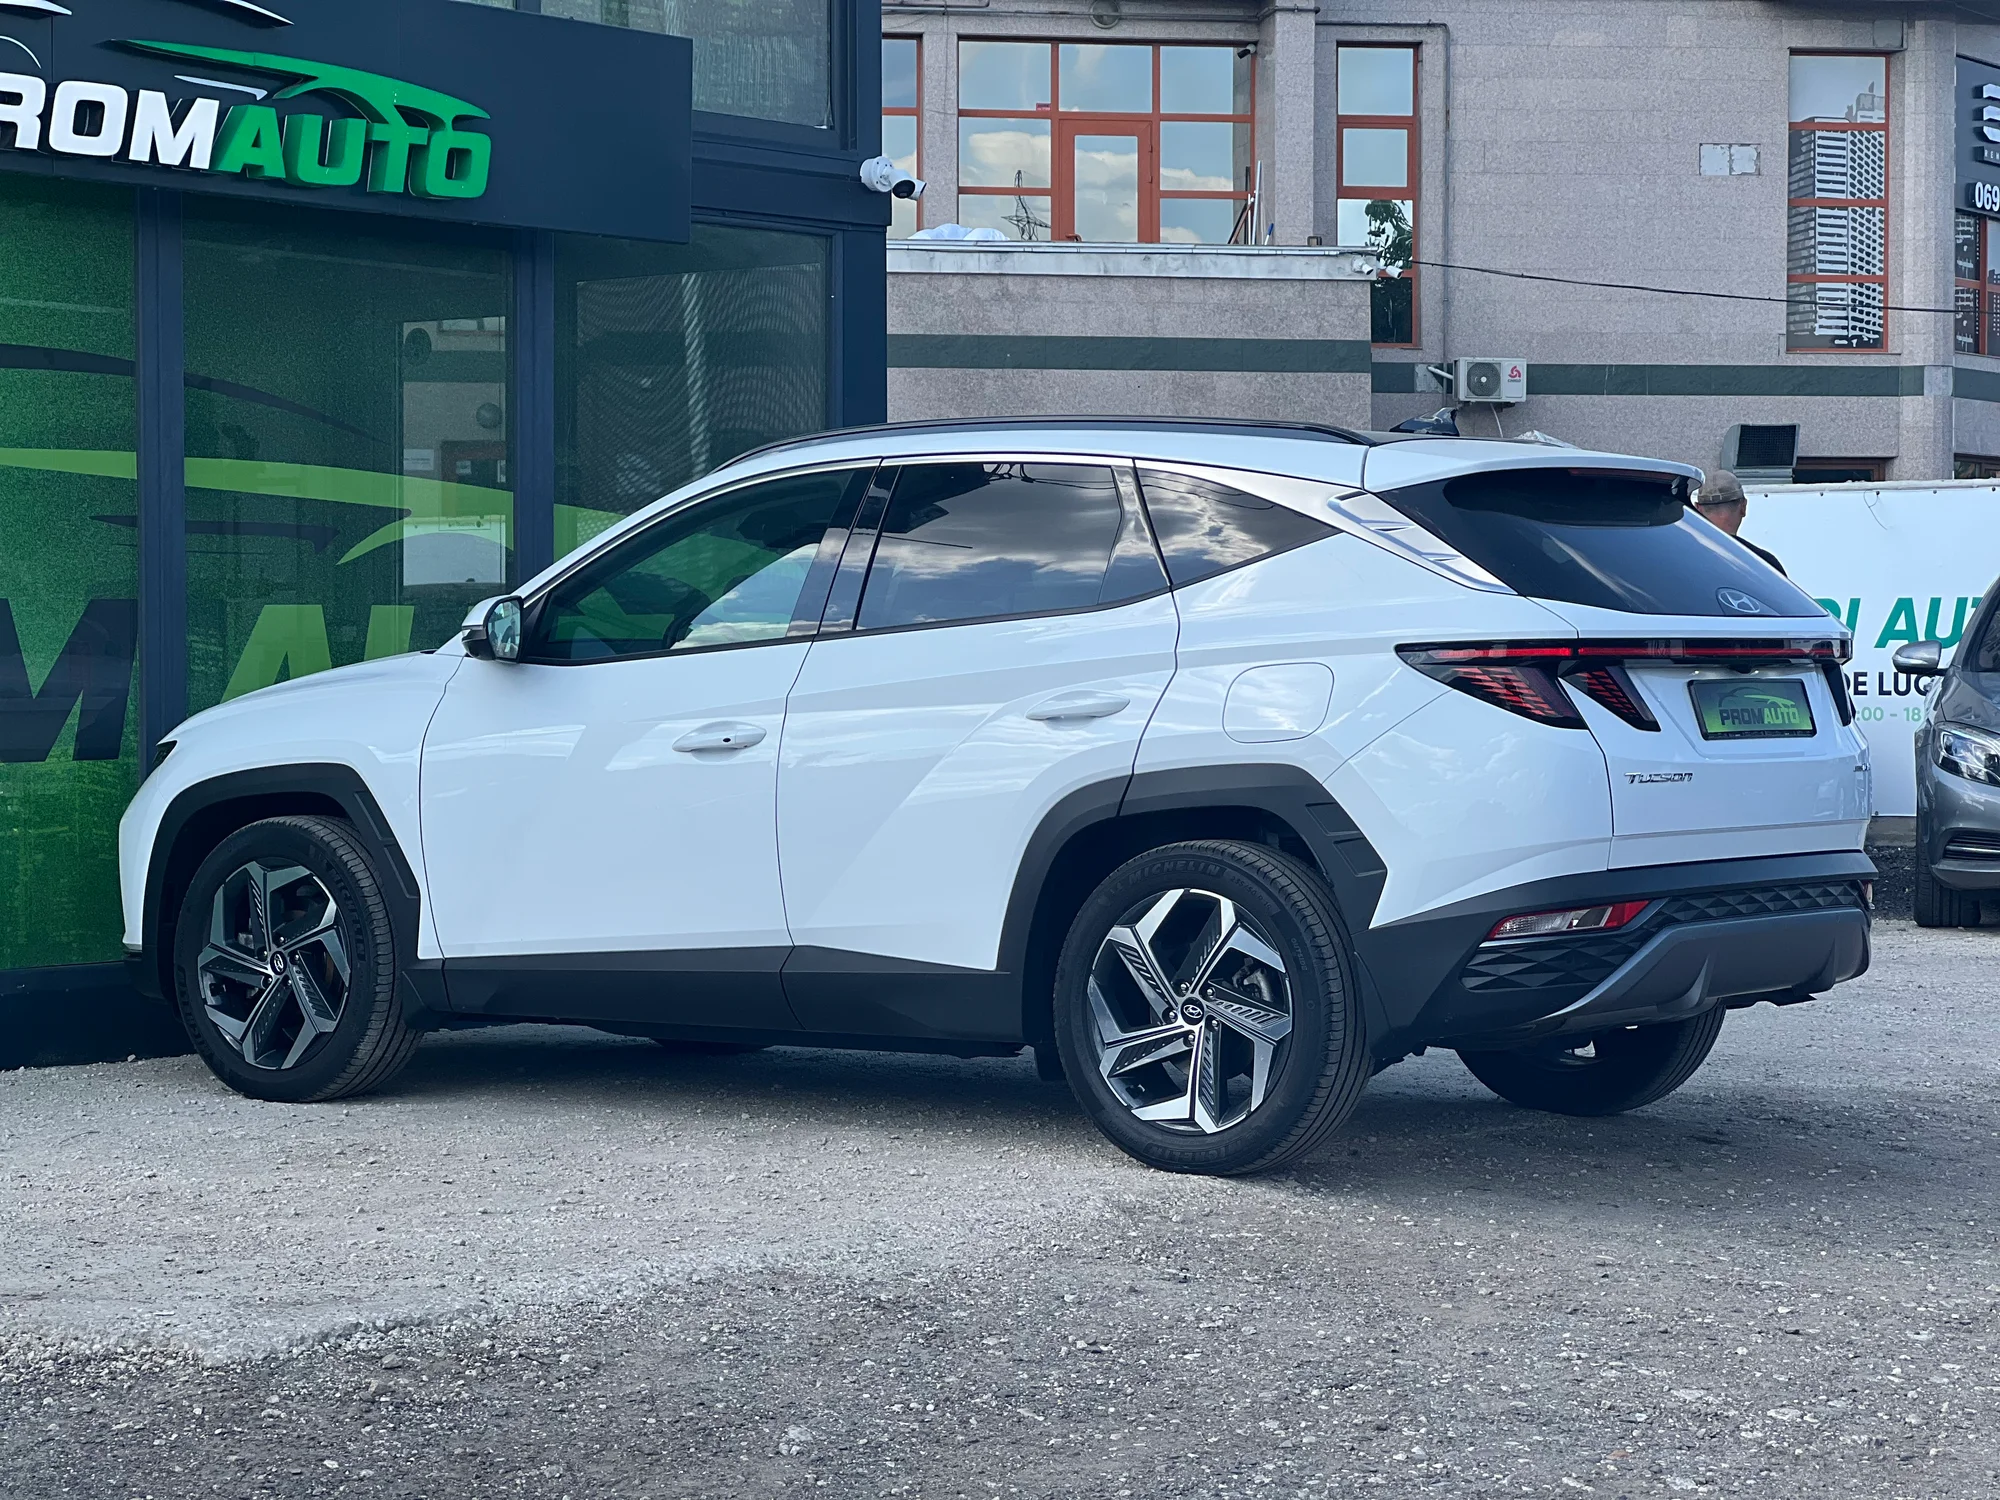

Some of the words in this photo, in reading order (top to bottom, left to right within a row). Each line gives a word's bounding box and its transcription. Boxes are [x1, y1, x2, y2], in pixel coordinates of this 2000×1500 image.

[1975, 181, 2000, 212] 069
[1844, 672, 1868, 696] E
[1719, 706, 1800, 726] PROMAUTO
[1903, 706, 1921, 722] 18
[1624, 771, 1693, 785] TUCSON
[1128, 859, 1222, 885] MICHELIN
